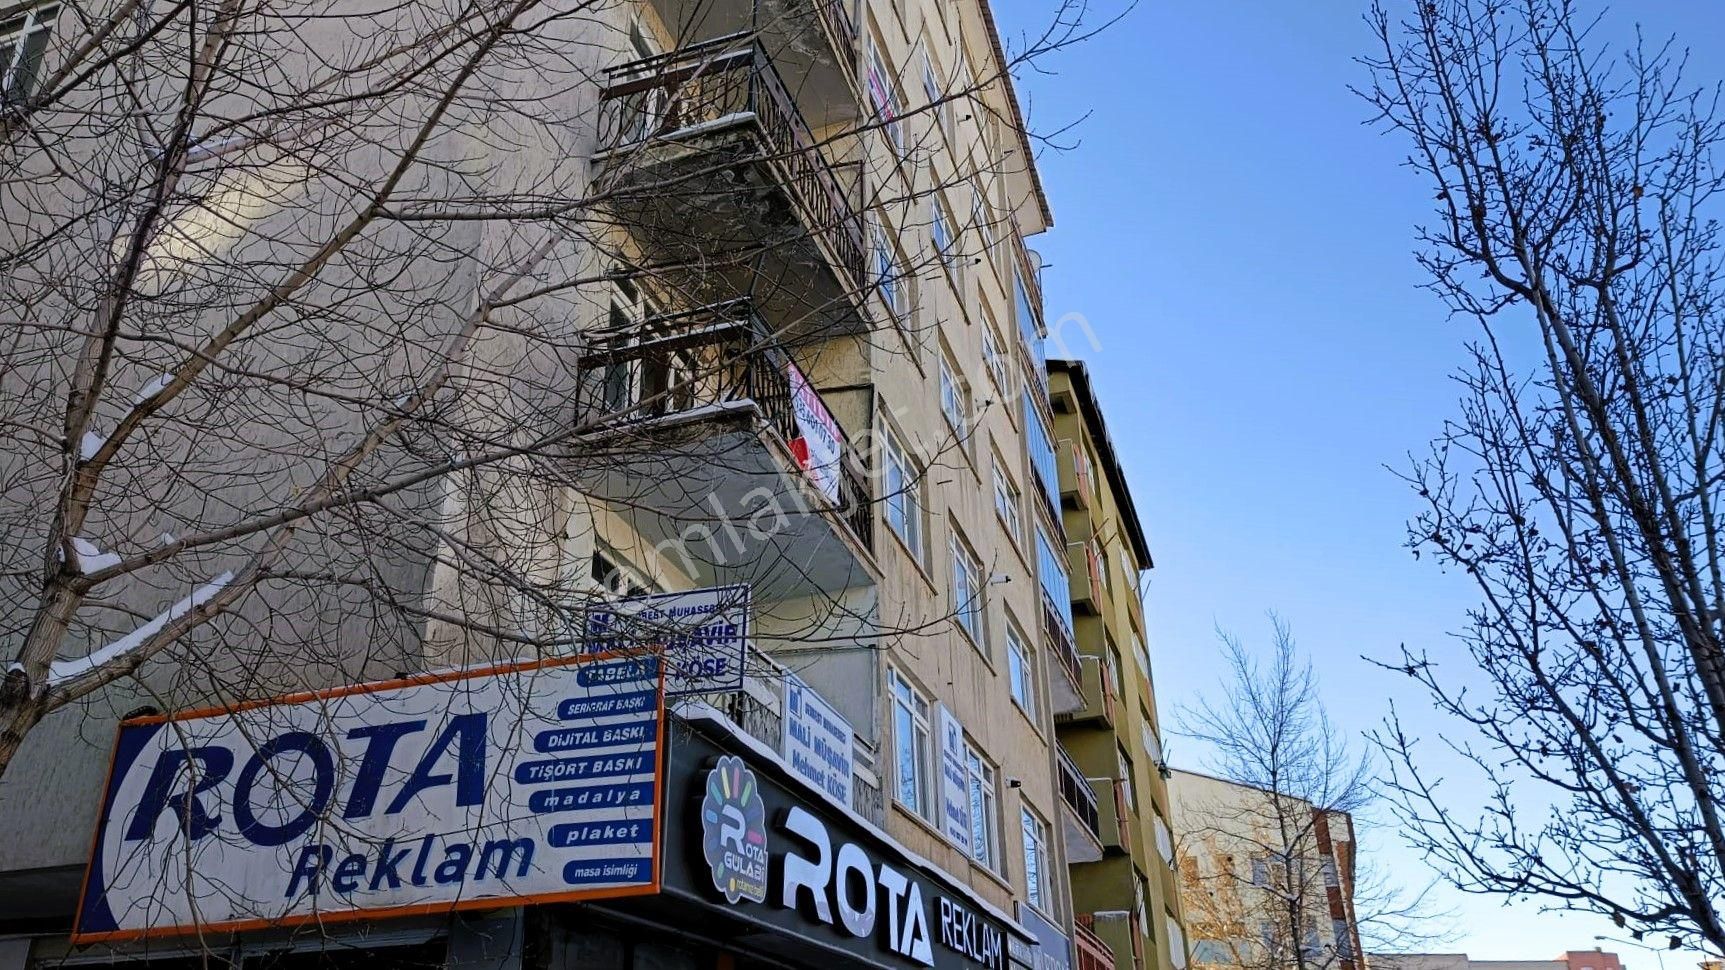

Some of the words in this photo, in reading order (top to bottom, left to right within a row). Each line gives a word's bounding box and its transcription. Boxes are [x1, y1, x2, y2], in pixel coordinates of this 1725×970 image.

[602, 726, 645, 742] BASKI
[592, 757, 643, 773] BASKI
[124, 712, 487, 847] ROTA
[544, 789, 641, 807] madalya
[566, 824, 640, 845] plaket
[284, 833, 535, 898] Reklam
[575, 867, 601, 878] masa
[602, 863, 638, 878] isimliği
[782, 805, 935, 967] ROTA
[940, 896, 1003, 970] REKLAM
